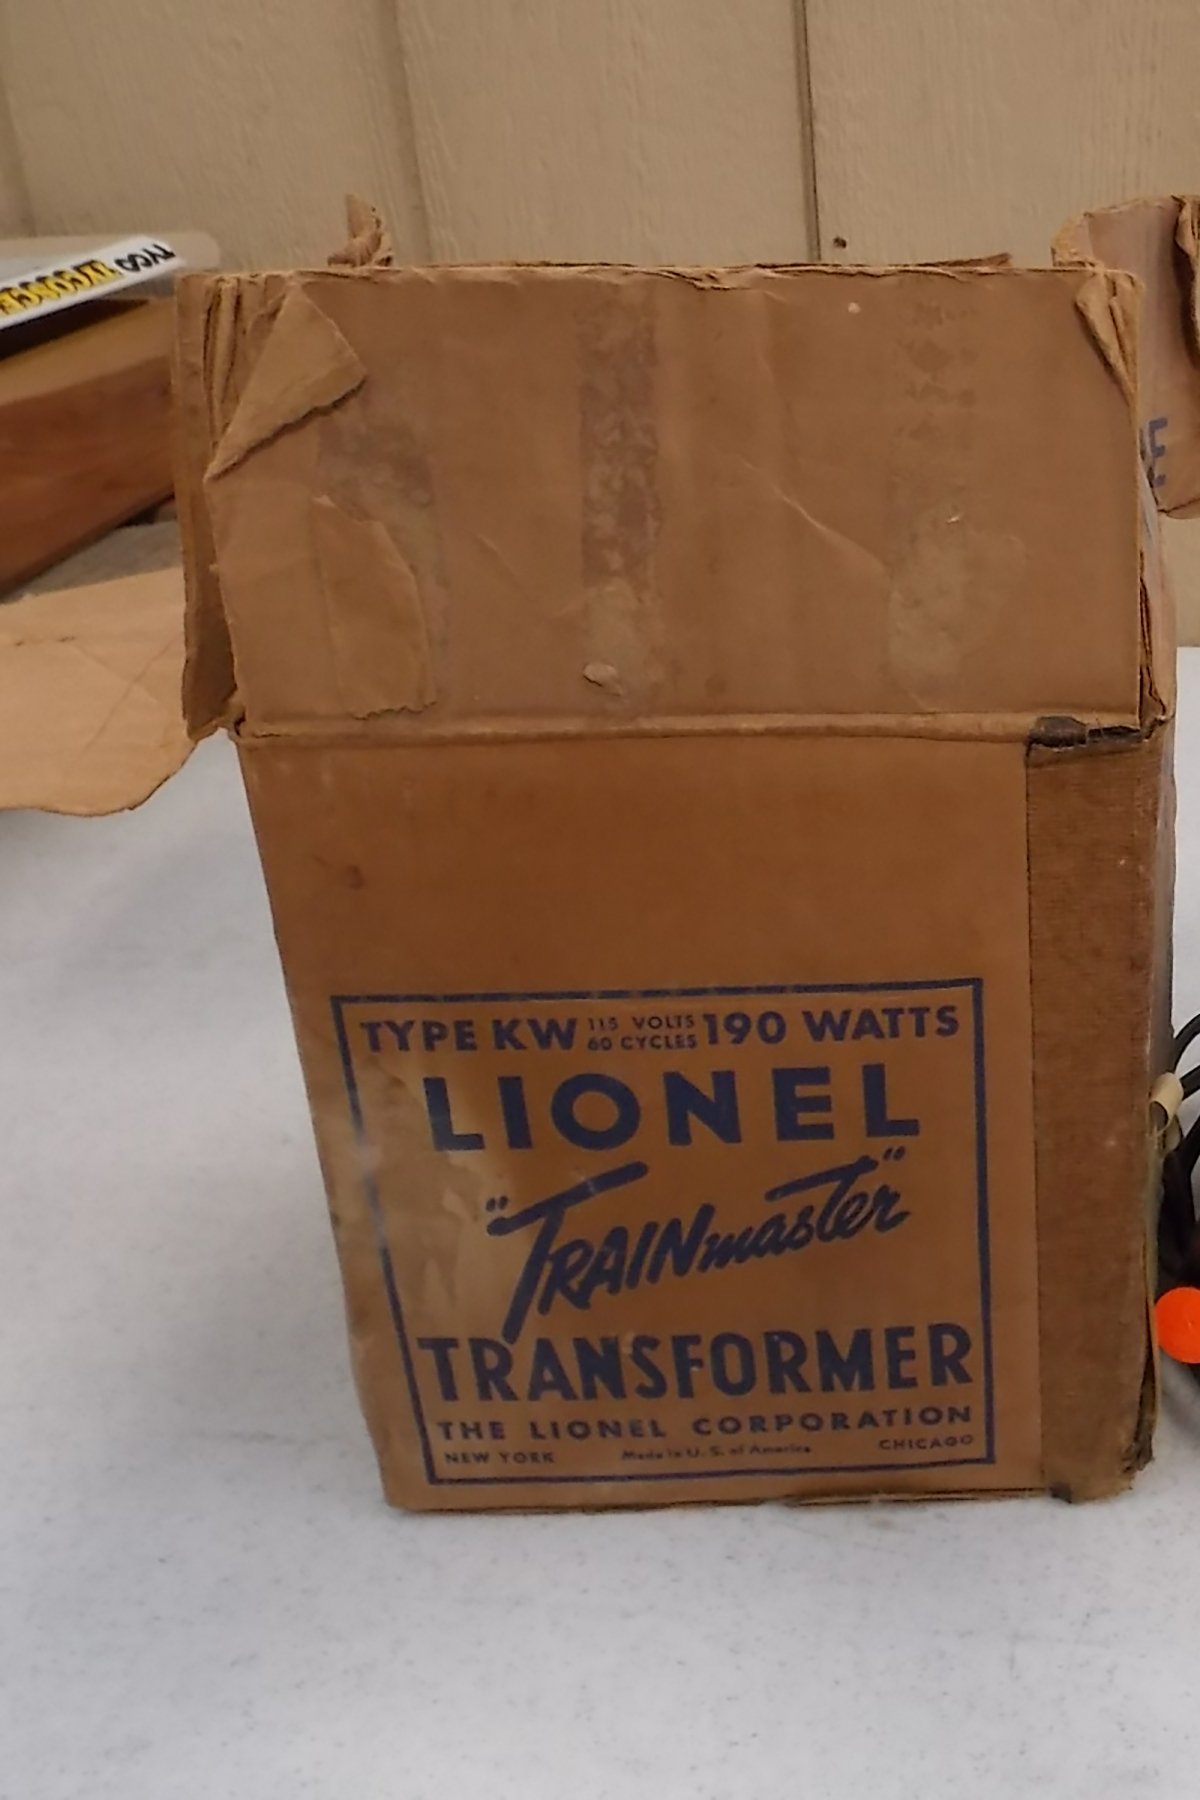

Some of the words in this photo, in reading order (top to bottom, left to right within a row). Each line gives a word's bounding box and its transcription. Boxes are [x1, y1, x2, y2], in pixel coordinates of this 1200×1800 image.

[359, 1018, 478, 1052] TYPE
[491, 1017, 578, 1051] KW
[586, 1016, 619, 1032] 115
[631, 1014, 695, 1031] VOLTS
[702, 1010, 787, 1046] 190
[801, 1004, 960, 1043] WATTS
[586, 1036, 613, 1052] 60
[620, 1033, 698, 1051] CYCLES
[422, 1063, 921, 1152] LIONEL
[416, 1322, 974, 1403] TRANSFORMER
[436, 1421, 506, 1441] THE
[528, 1418, 668, 1442] LIONEL
[691, 1405, 973, 1437] CORPORATION
[444, 1451, 491, 1465] NEW
[499, 1451, 556, 1465] YORK
[877, 1433, 975, 1452] CHICAGO
